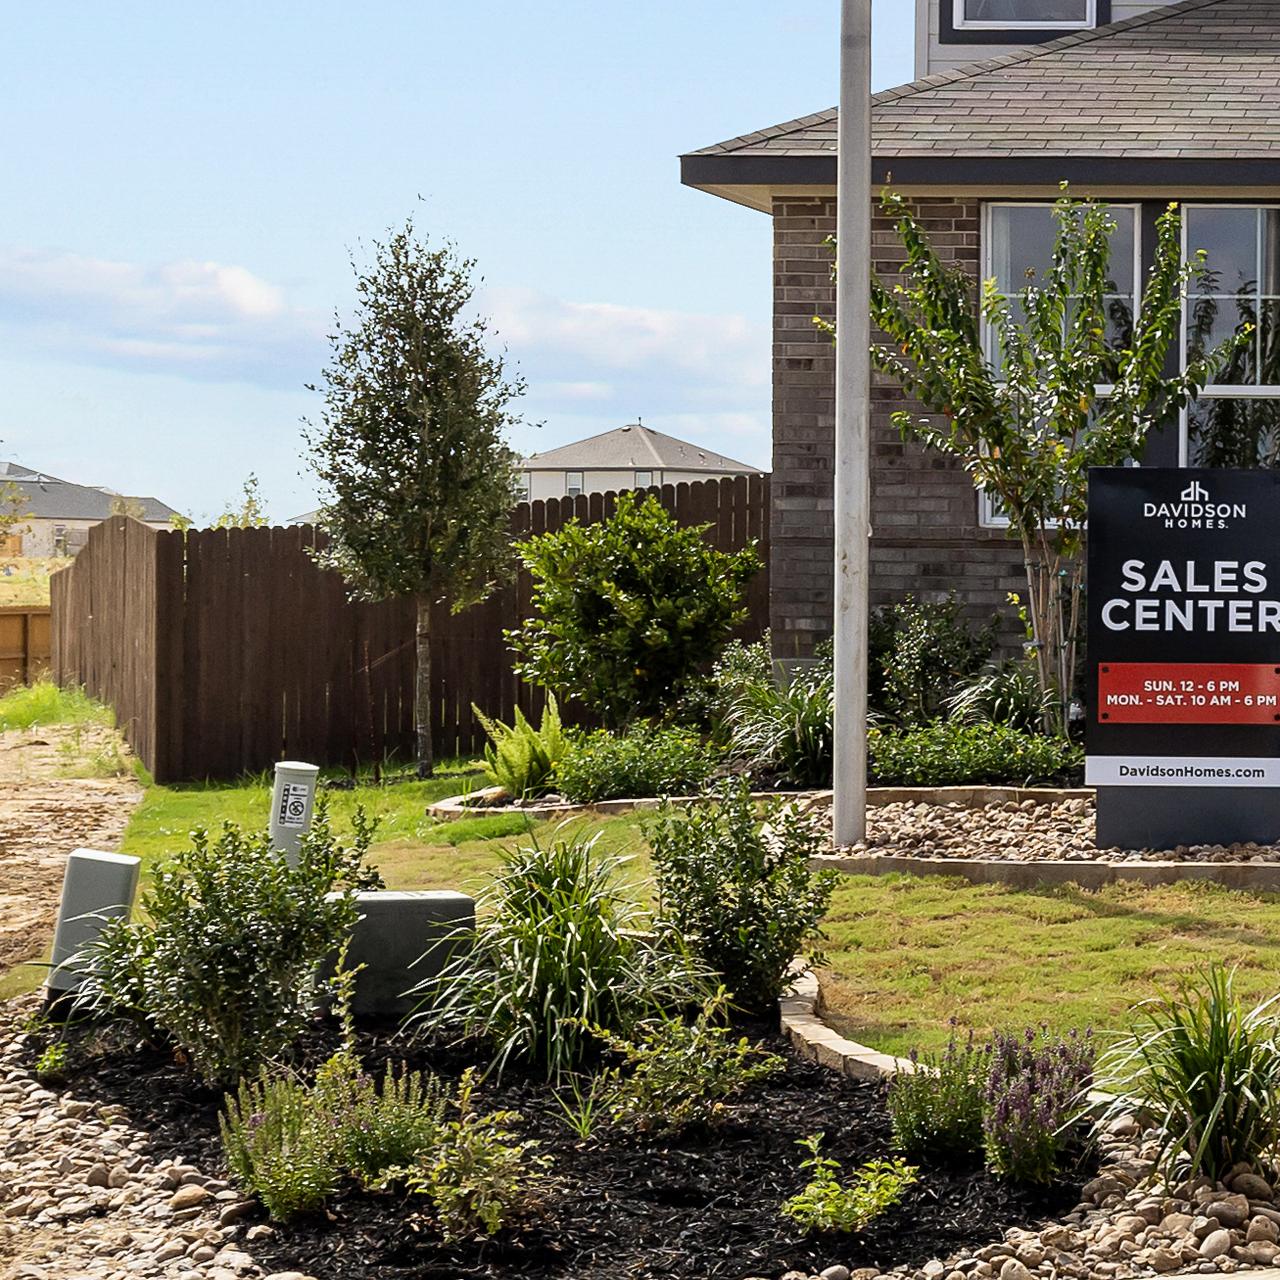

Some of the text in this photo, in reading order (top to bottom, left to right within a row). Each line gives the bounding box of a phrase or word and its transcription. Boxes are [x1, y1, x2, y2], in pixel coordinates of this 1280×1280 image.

[1144, 503, 1246, 518] DAVIDSON
[1121, 559, 1267, 594] SALES
[1144, 680, 1177, 692] SUN.
[1180, 680, 1194, 692] 12
[1206, 680, 1216, 692] 6
[1219, 681, 1240, 692] PM
[1107, 694, 1144, 706] MON.
[1156, 694, 1187, 706] SAT.
[1190, 695, 1206, 706] 10
[1209, 695, 1231, 706] AM
[1244, 695, 1253, 706] 6
[1256, 695, 1277, 706] PM
[1119, 765, 1265, 778] DavidsonHomes.com
